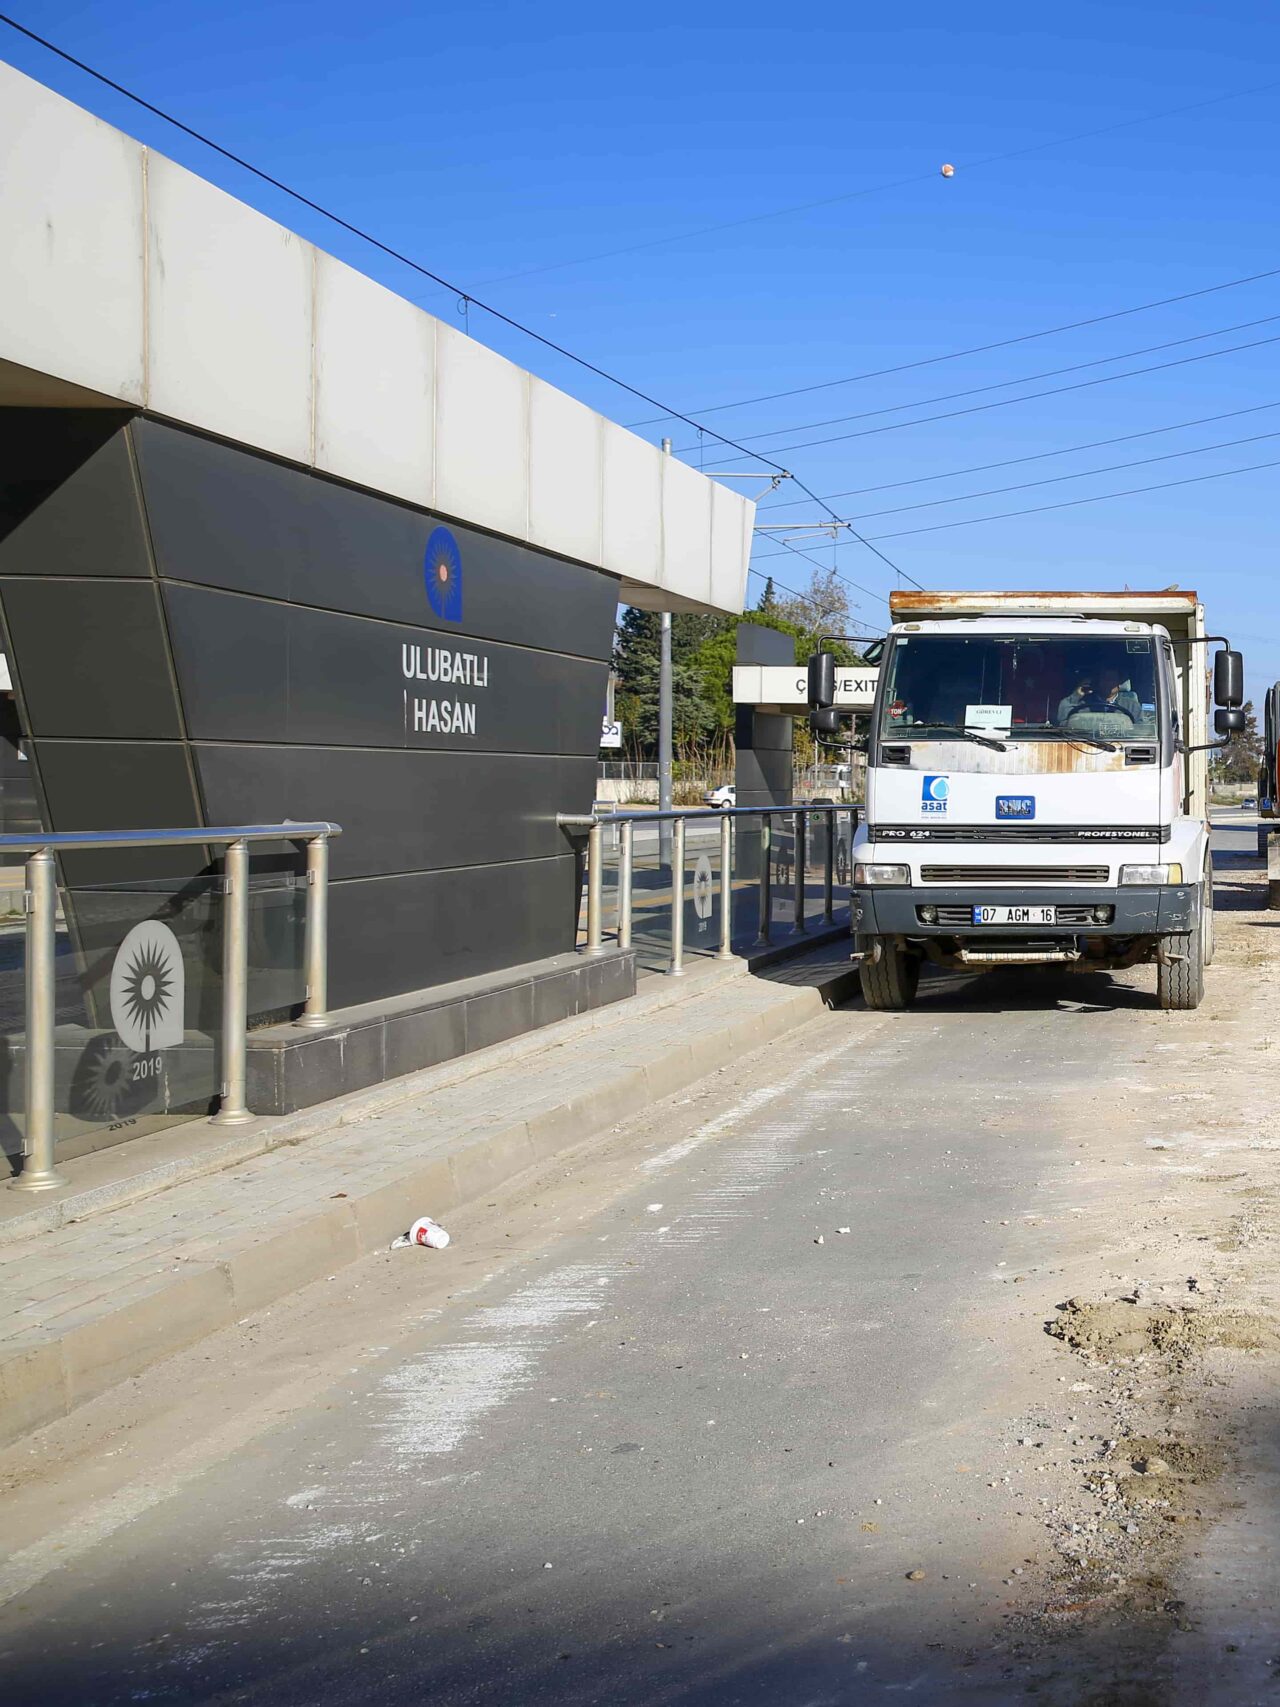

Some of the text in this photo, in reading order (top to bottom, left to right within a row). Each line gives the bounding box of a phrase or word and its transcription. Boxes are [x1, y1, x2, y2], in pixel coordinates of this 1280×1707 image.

[402, 643, 488, 687] ULUBATLI
[414, 697, 476, 735] HASAN
[921, 802, 948, 811] asat
[982, 908, 997, 921] 07
[1007, 908, 1030, 922] AGM
[1041, 908, 1052, 922] 16
[132, 1056, 163, 1081] 2019
